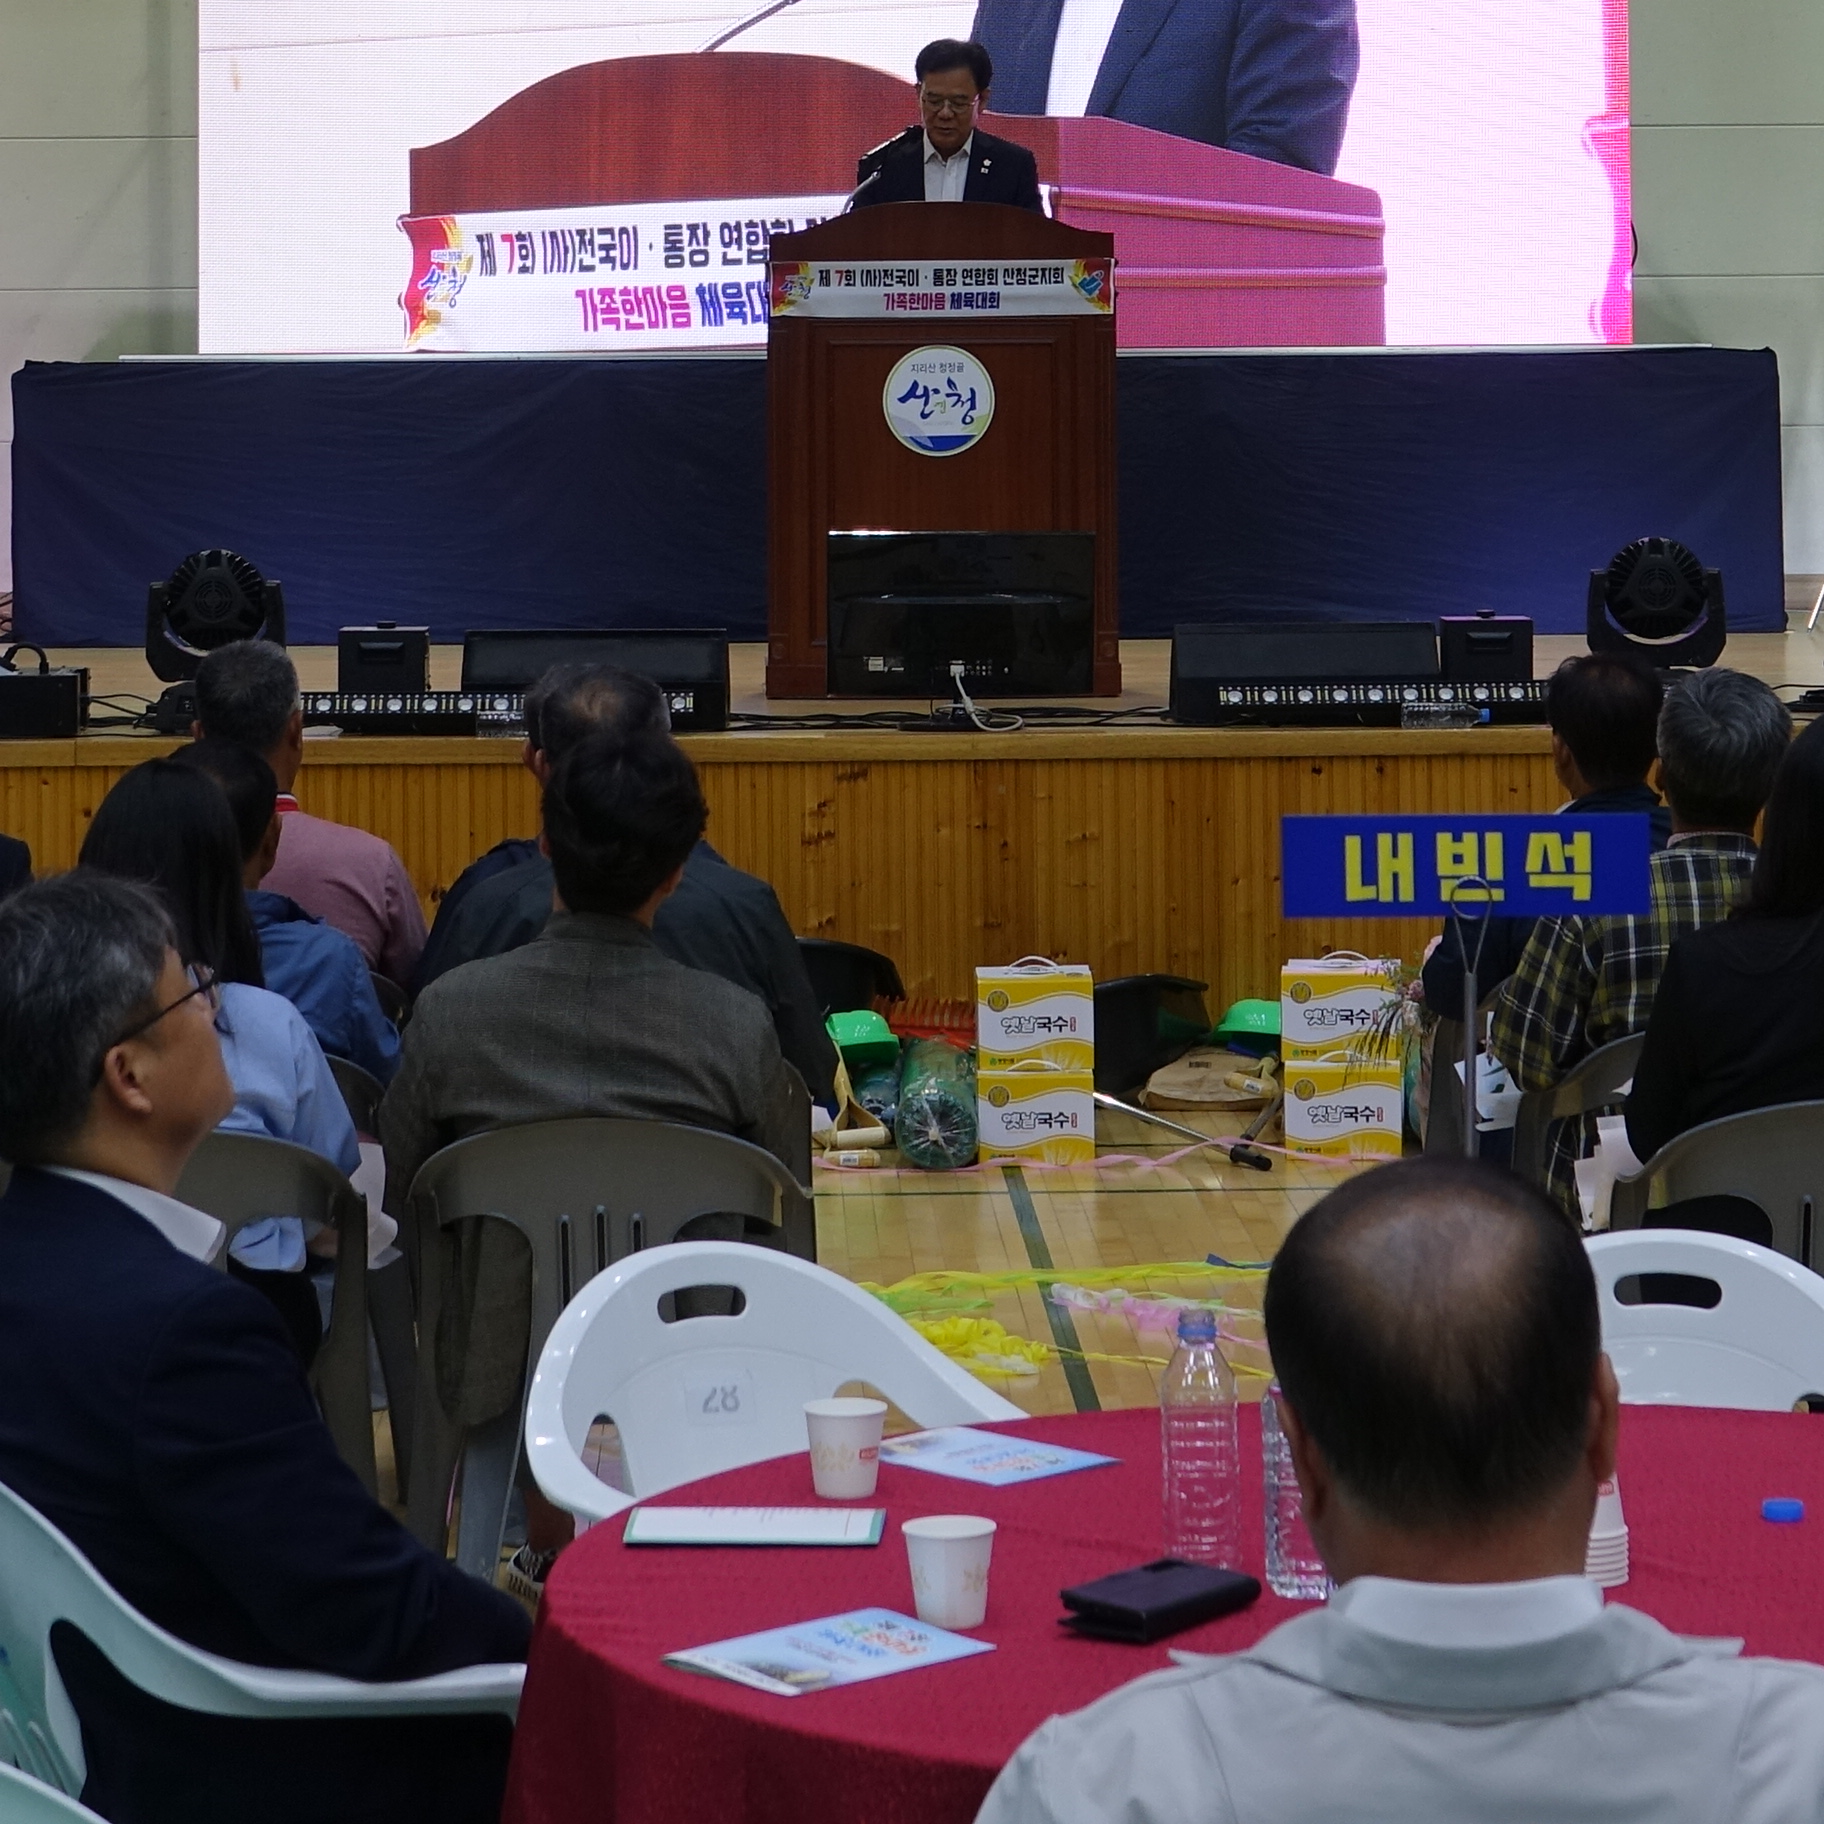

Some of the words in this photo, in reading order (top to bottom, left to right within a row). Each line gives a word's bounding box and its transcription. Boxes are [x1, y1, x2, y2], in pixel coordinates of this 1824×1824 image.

[477, 232, 496, 277] 제
[501, 230, 537, 276] 7회
[542, 224, 640, 274] (사)전국이
[663, 222, 712, 269] 통장
[818, 270, 831, 288] 제
[836, 269, 856, 288] 7회
[860, 269, 920, 288] (사)전국이
[932, 269, 958, 288] 통장
[962, 268, 999, 287] 연합회
[1003, 267, 1065, 286] 산청군지회
[575, 285, 692, 332] 가족한마음
[883, 293, 946, 311] 가족한마음
[950, 292, 1001, 310] 체육대회
[911, 363, 936, 374] 지리산
[939, 362, 965, 374] 청정골
[1344, 831, 1592, 902] 내빈석
[1001, 1015, 1069, 1034] 옛날국수
[1303, 1008, 1370, 1026] 옛날국수
[1001, 1112, 1070, 1131] 옛날국수
[1307, 1104, 1377, 1123] 옛날국수
